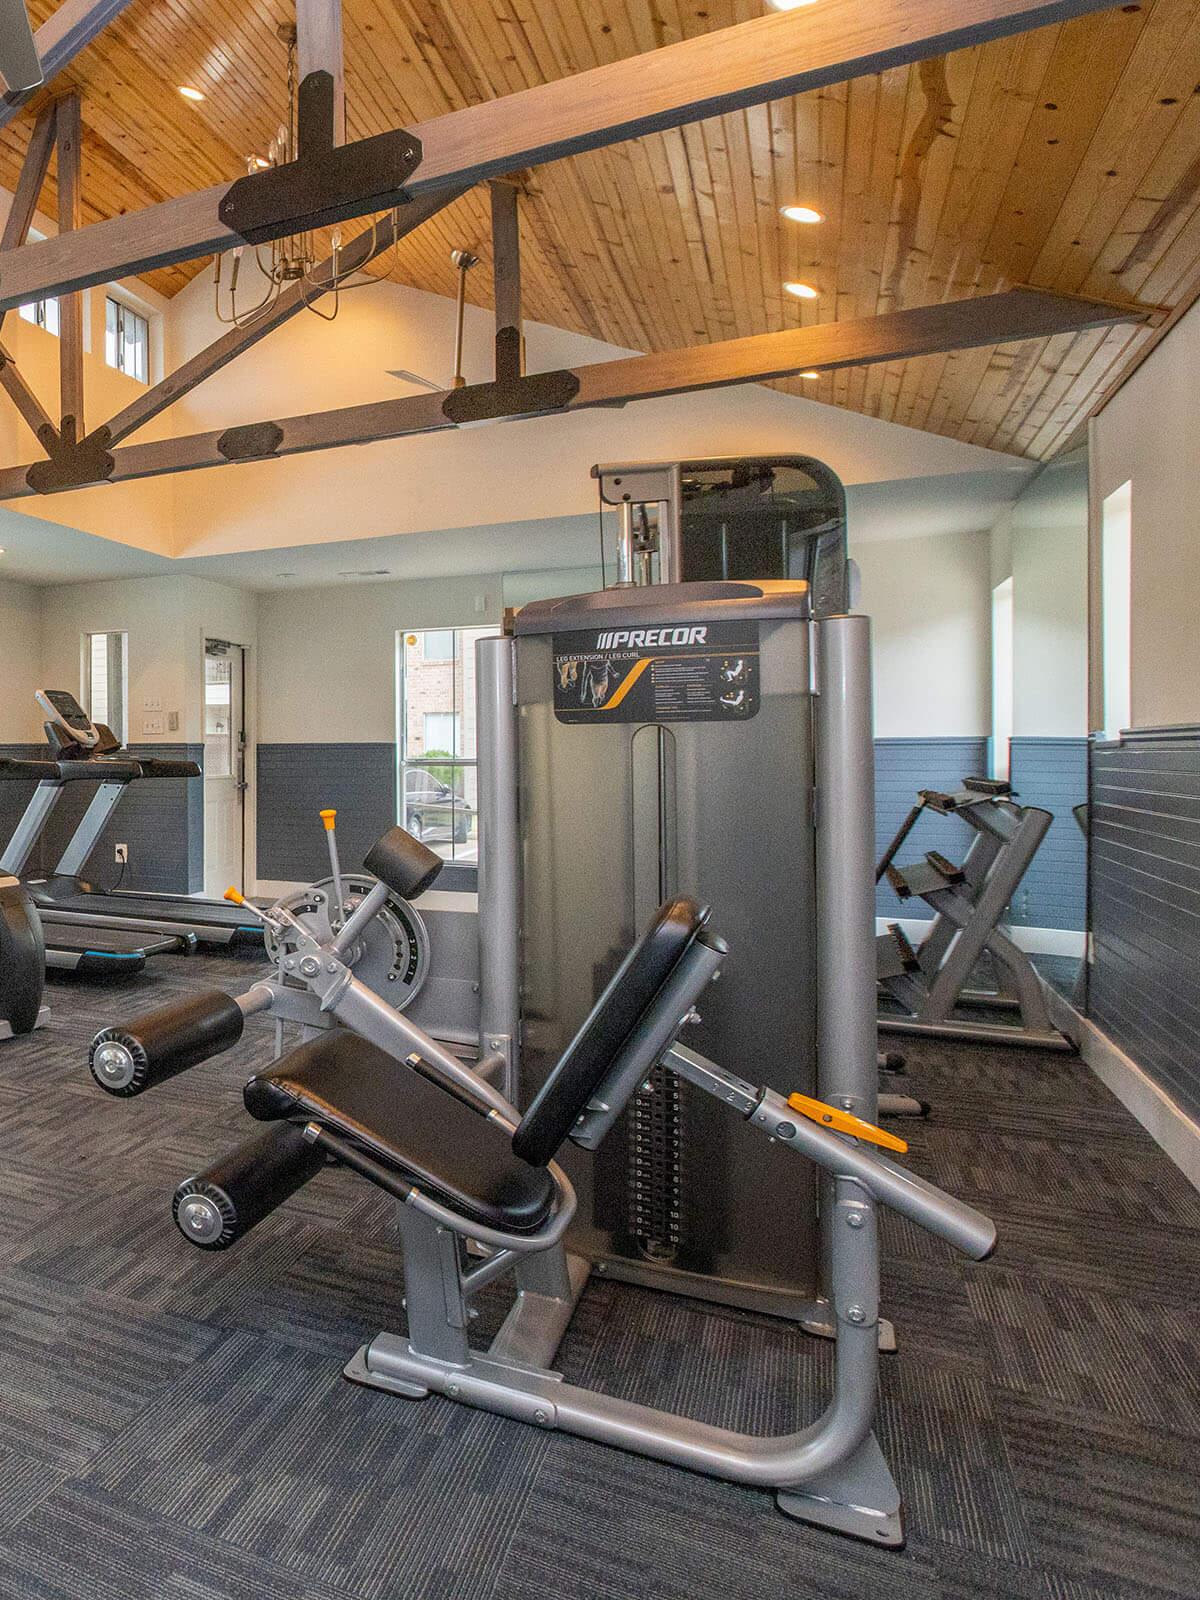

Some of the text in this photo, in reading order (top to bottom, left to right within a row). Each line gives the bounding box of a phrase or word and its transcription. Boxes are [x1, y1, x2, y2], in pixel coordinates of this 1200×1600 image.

[610, 626, 708, 649] PRECOR
[556, 655, 569, 663] LEG
[569, 653, 604, 662] EXTENSION
[608, 652, 622, 660] LEG
[622, 651, 641, 659] CURL
